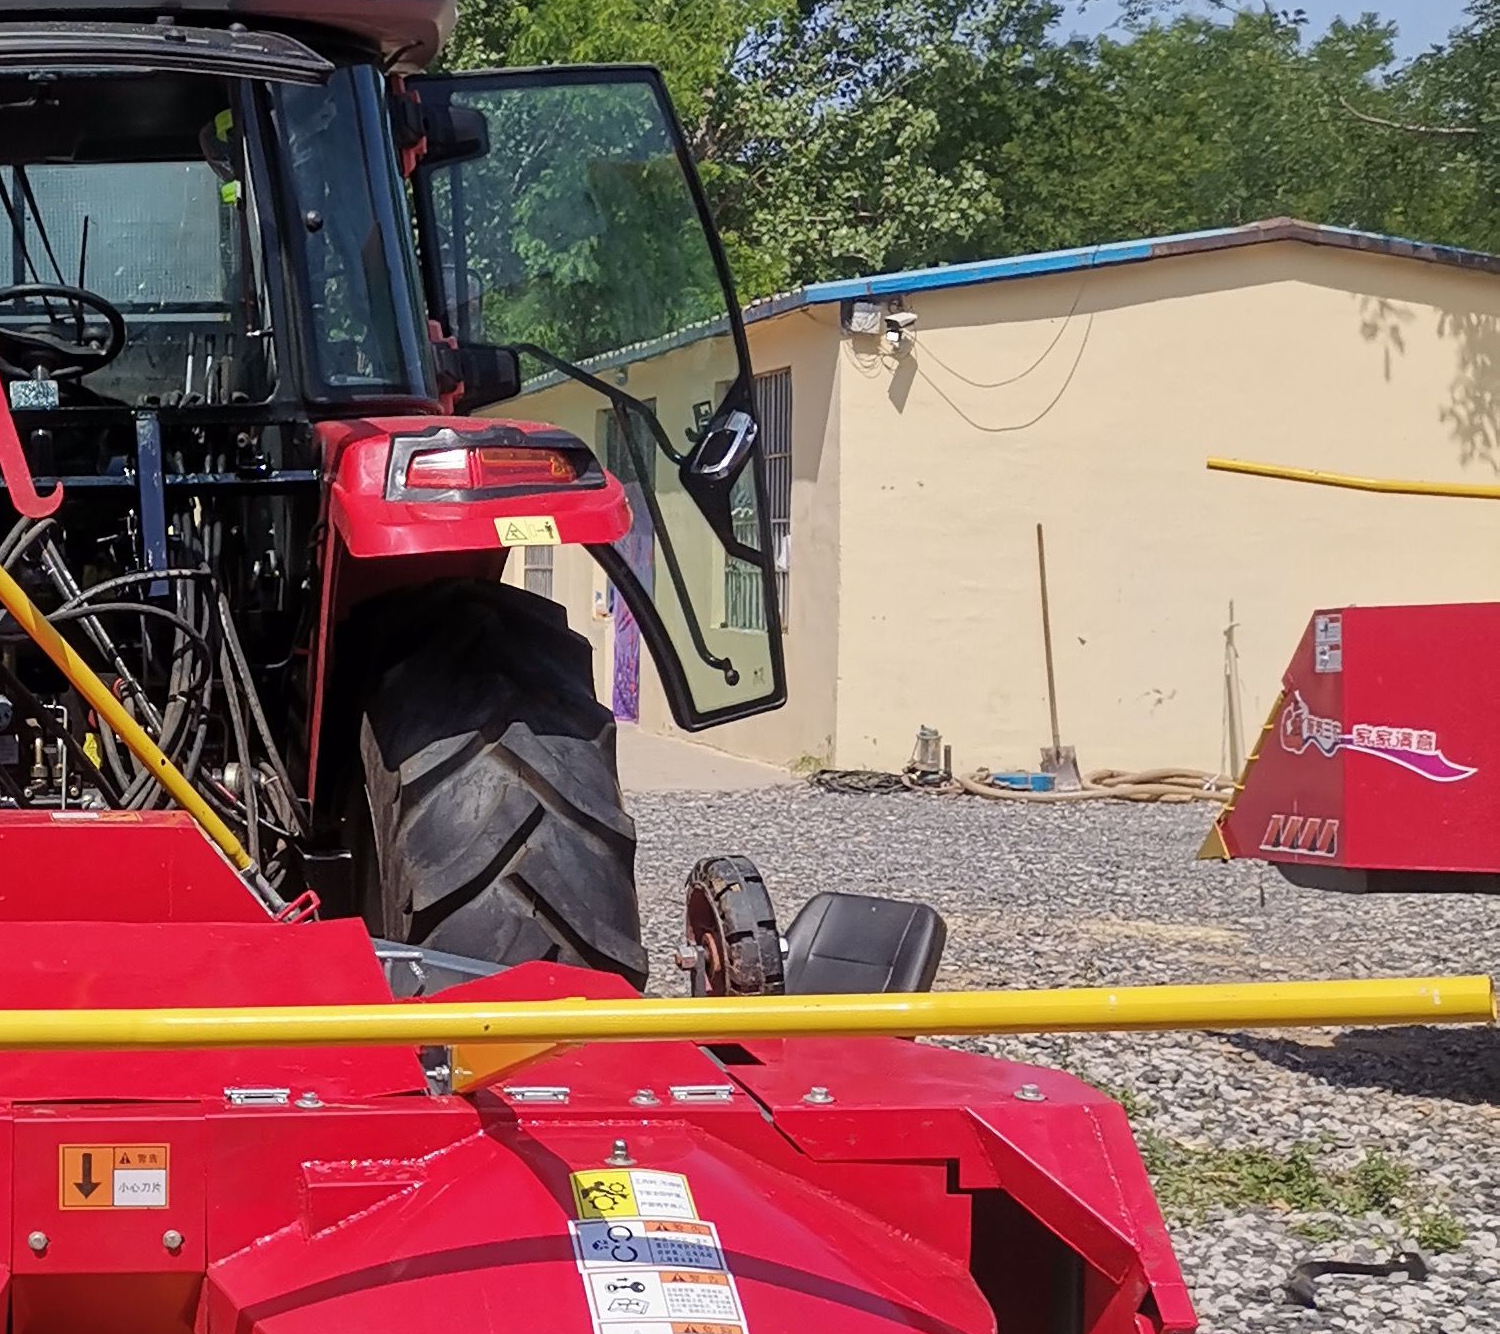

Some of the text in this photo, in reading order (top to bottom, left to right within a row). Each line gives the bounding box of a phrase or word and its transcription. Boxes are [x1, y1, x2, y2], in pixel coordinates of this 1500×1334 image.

[1355, 727, 1433, 751] 家家满意
[118, 1181, 161, 1193] 小心刀片
